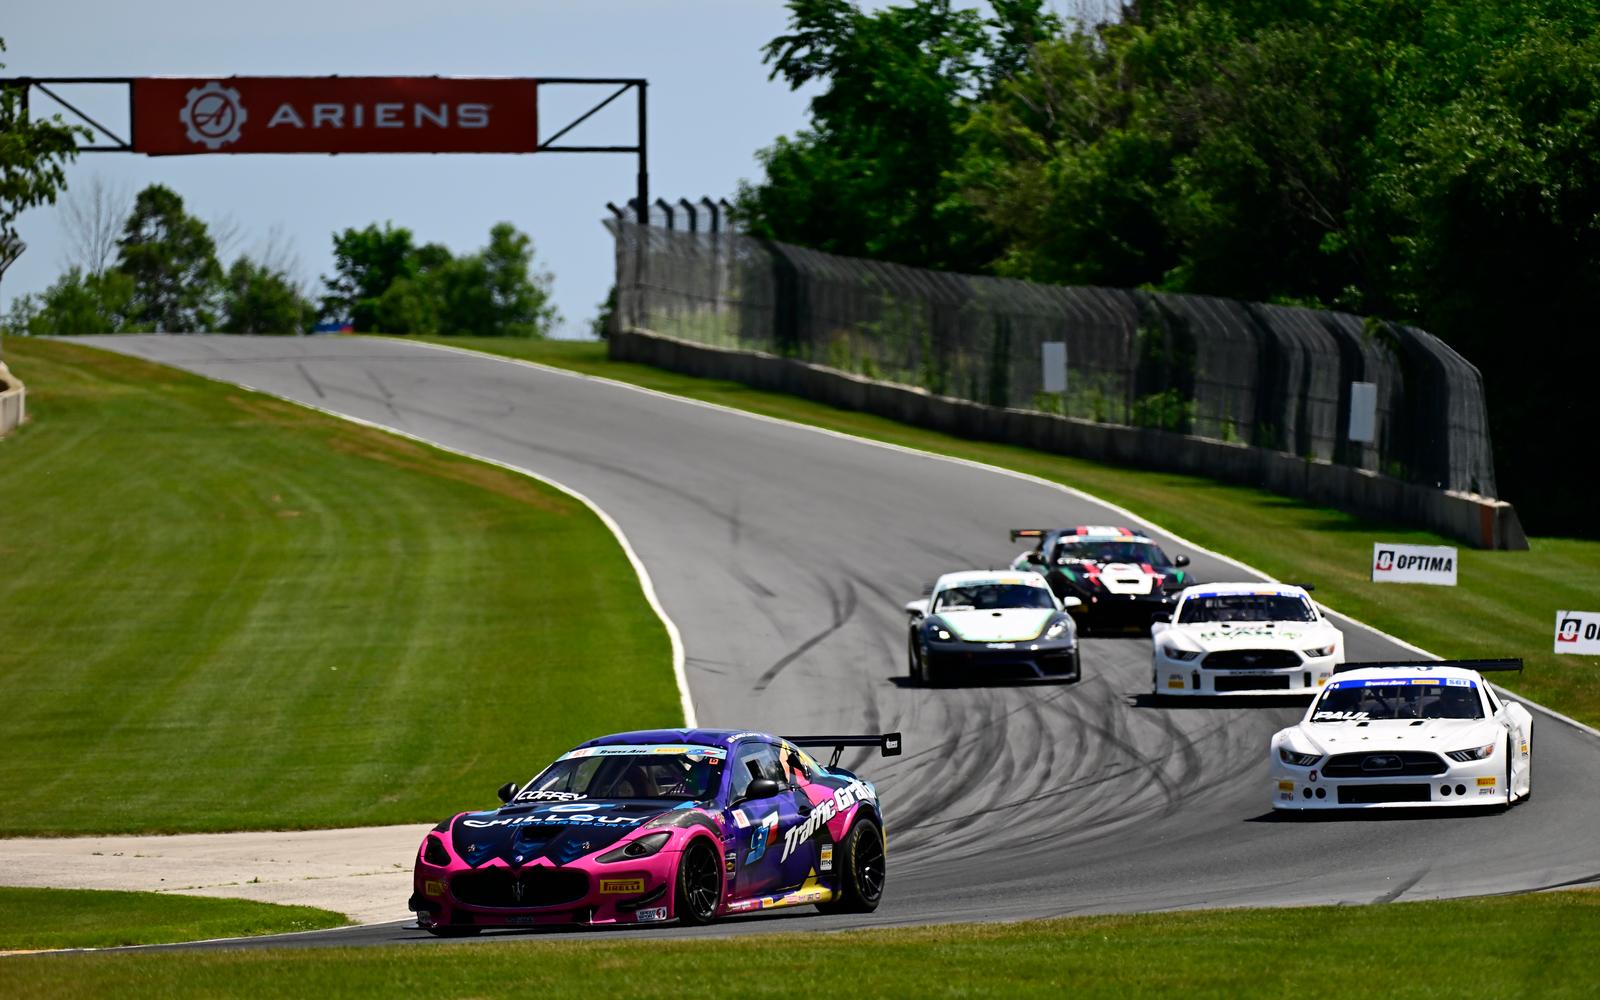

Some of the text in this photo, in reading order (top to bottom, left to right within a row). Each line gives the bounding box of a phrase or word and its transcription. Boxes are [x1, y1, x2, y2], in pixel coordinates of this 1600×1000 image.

[267, 103, 490, 128] ARIENS
[1397, 554, 1452, 572] OPTIMA
[1312, 711, 1370, 720] PAUL
[517, 790, 588, 801] COFFEY
[744, 810, 779, 866] 97
[780, 799, 836, 864] Traffic
[604, 880, 641, 892] PIRELLI
